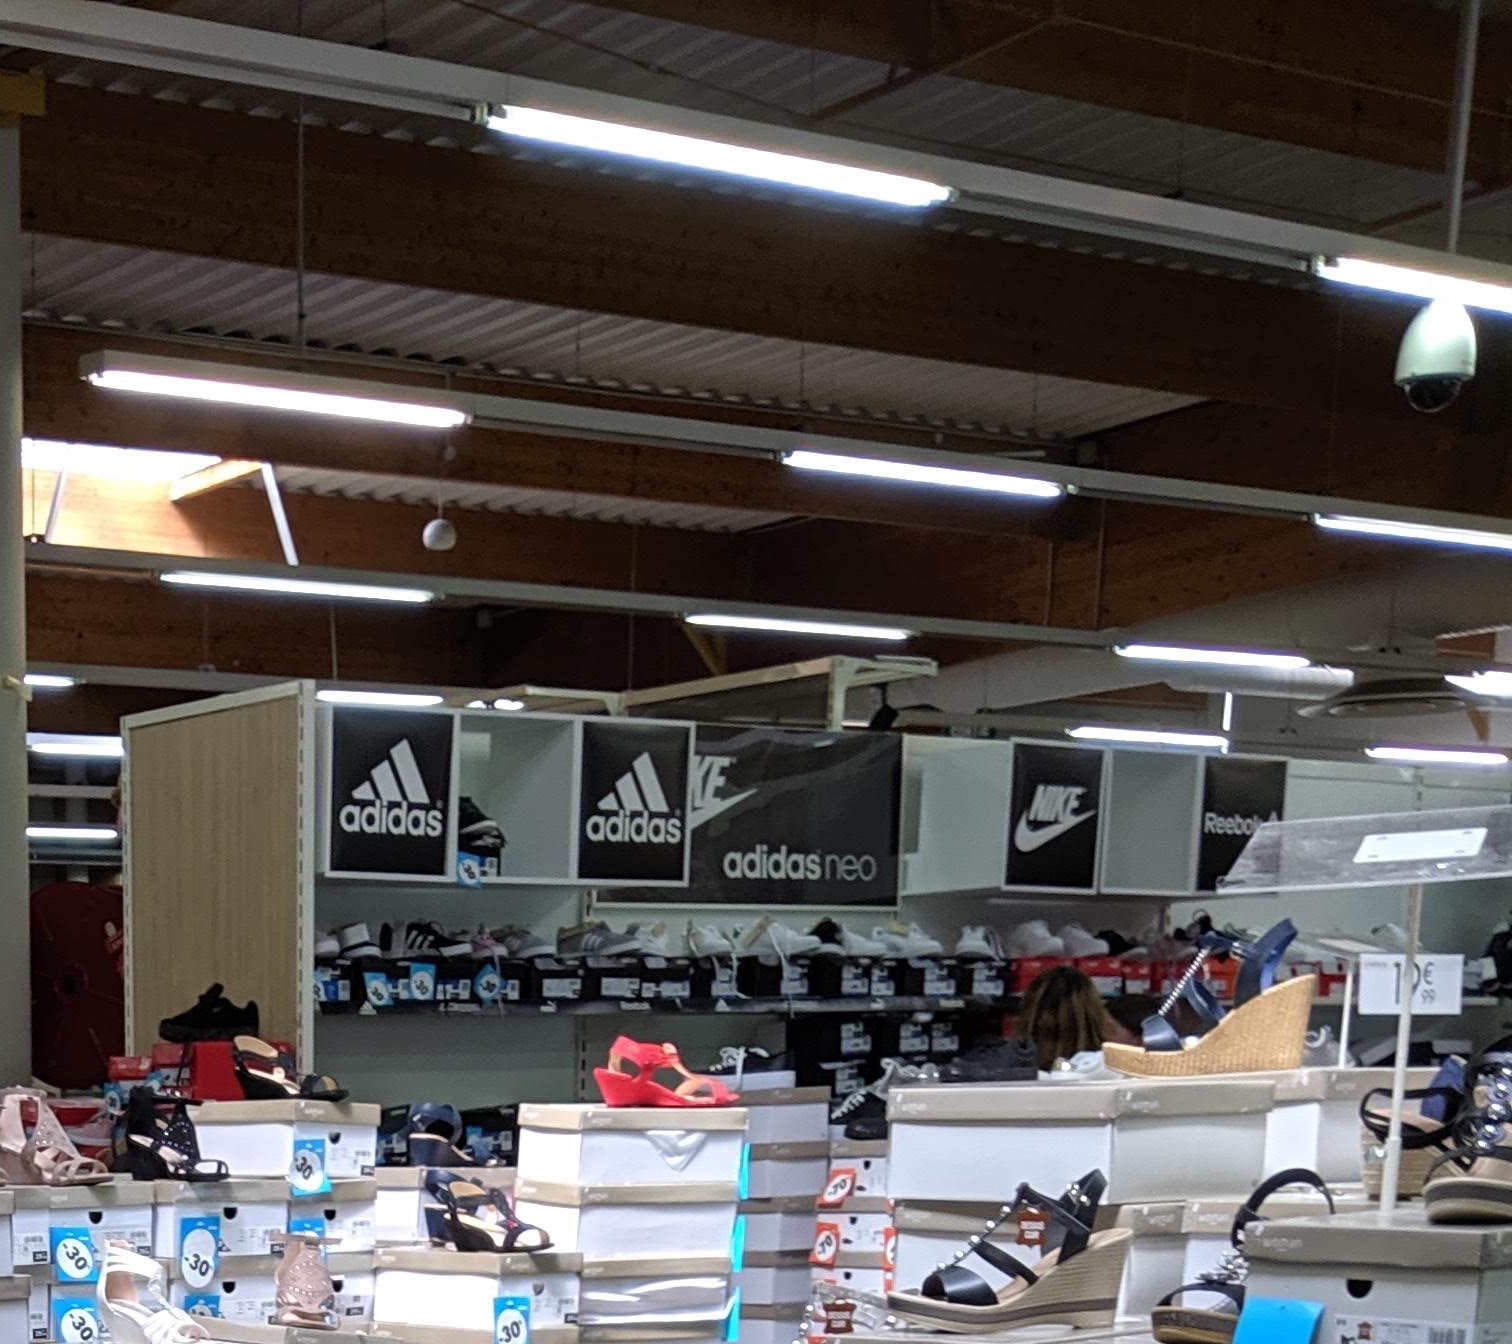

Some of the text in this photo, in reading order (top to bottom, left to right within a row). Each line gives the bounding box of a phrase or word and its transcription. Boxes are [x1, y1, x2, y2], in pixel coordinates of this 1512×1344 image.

[339, 801, 443, 838] adidas
[1035, 785, 1086, 823] NIKE
[587, 810, 682, 844] adidas
[723, 843, 878, 881] adidas neo
